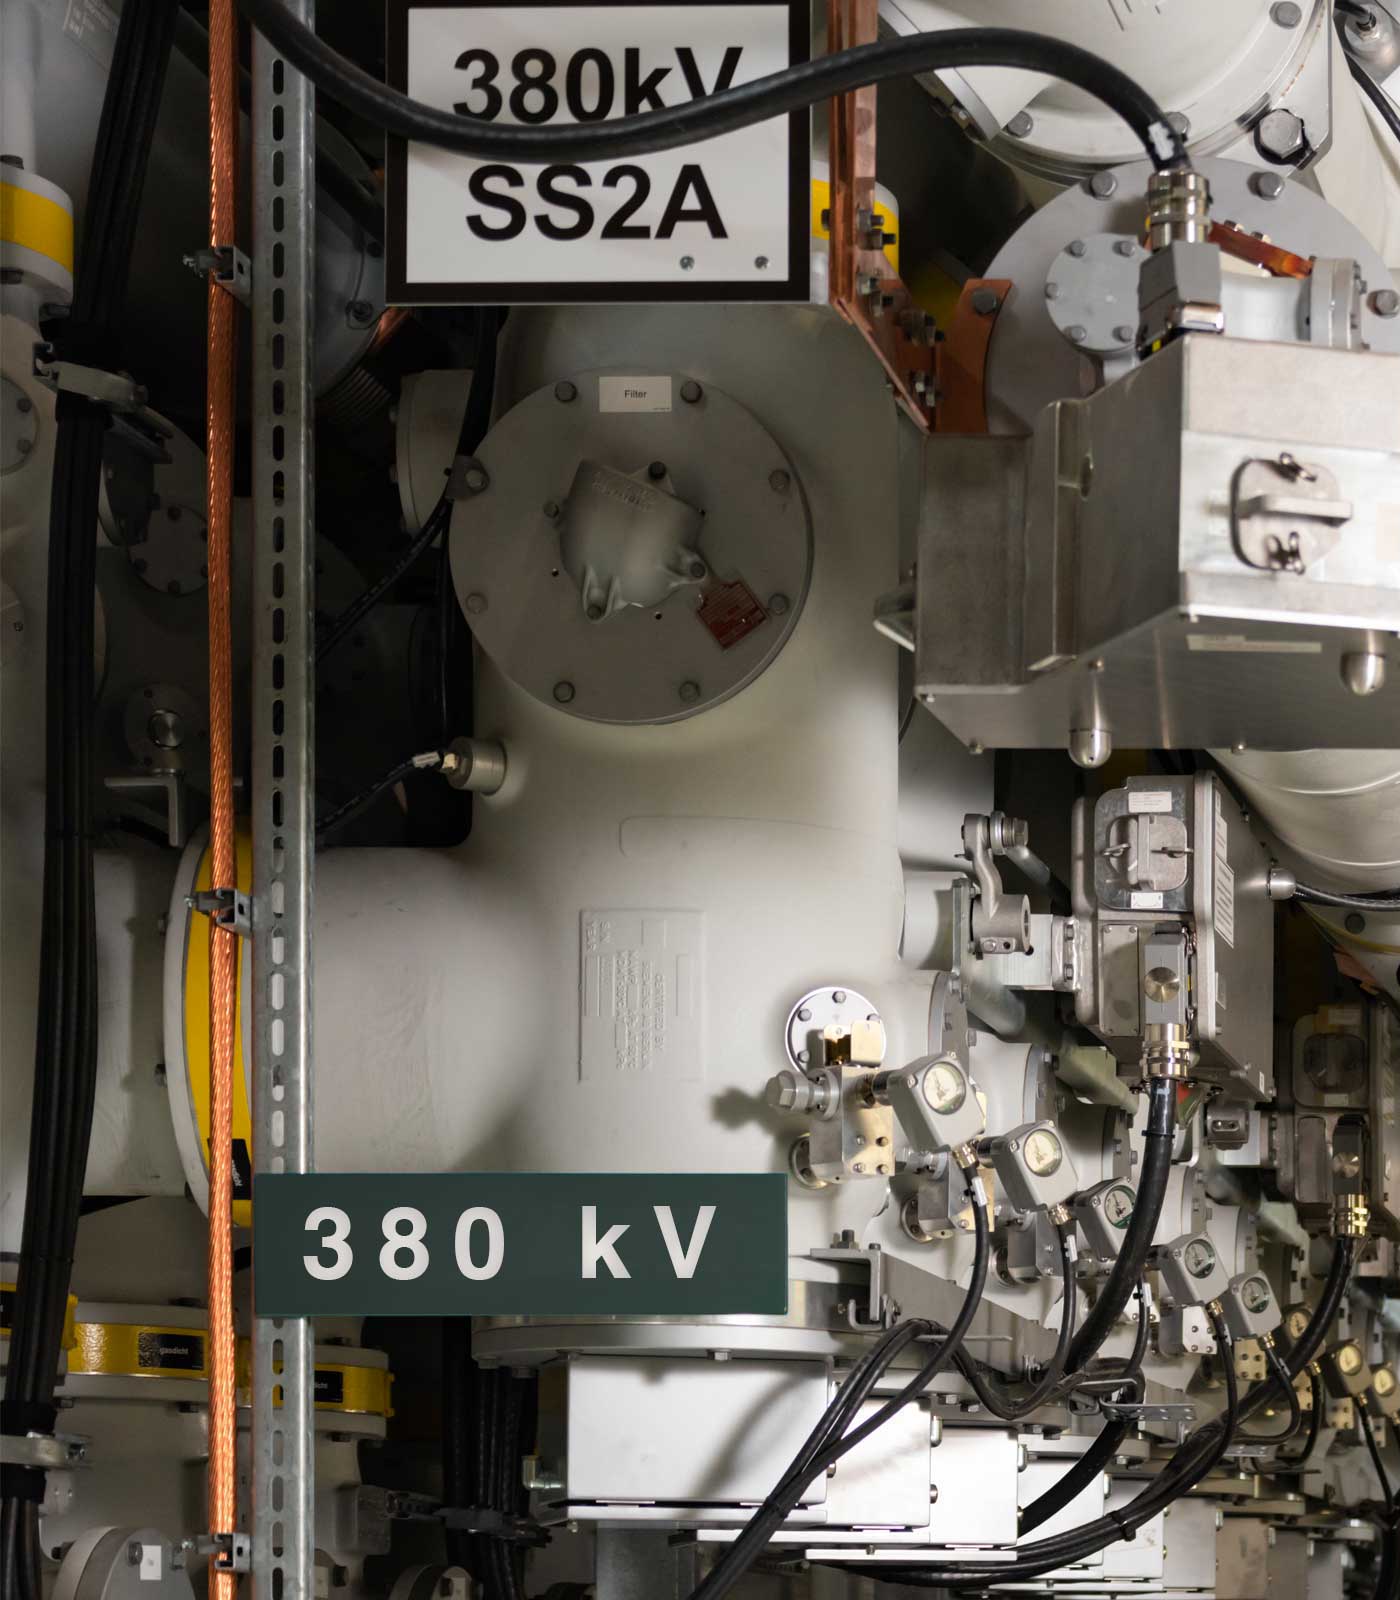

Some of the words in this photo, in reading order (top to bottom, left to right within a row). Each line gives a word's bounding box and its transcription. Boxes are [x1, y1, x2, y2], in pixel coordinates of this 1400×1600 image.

[453, 47, 743, 124] 380kV
[465, 164, 729, 241] SS2A
[624, 389, 647, 399] Filter
[303, 1206, 505, 1281] 380
[581, 1206, 717, 1279] kV
